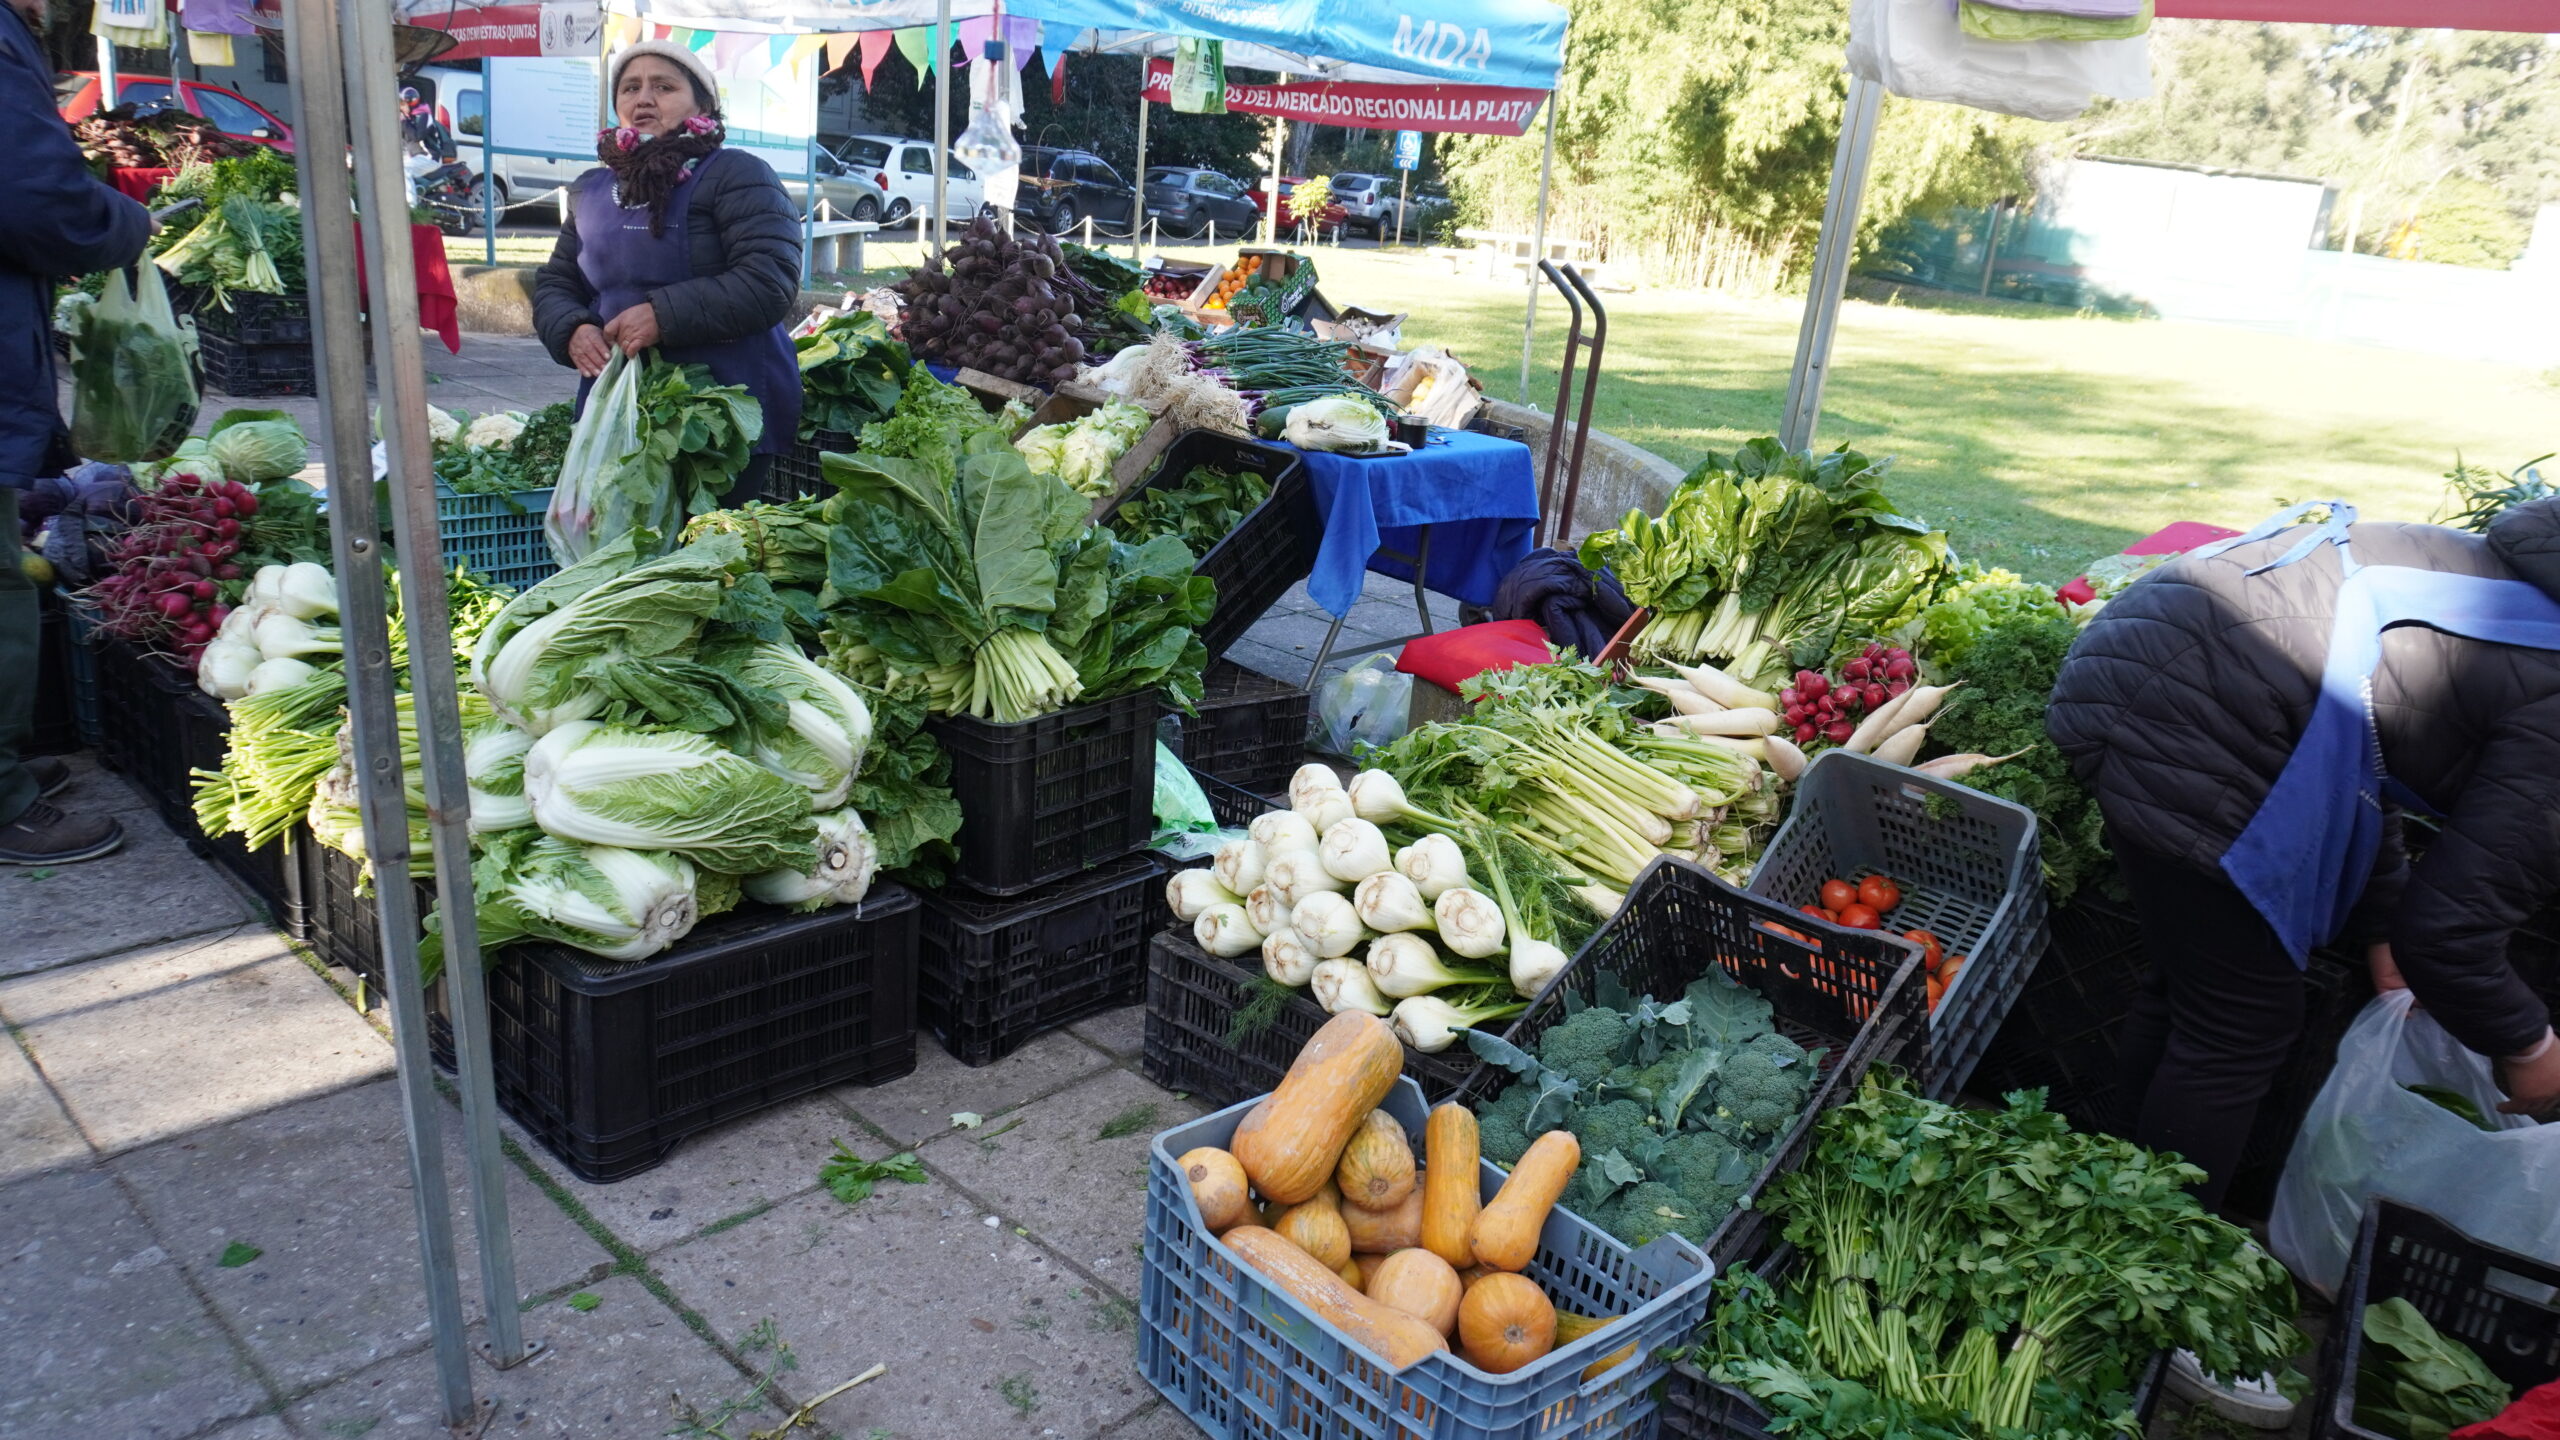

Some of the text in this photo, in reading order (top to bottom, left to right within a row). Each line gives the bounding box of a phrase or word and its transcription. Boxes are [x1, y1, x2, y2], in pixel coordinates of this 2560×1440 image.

[1180, 1, 1238, 23] BUENOS
[1241, 9, 1279, 26] AIRES
[507, 23, 537, 43] QUINTAS
[1393, 14, 1491, 70] MDA
[1244, 89, 1534, 122] DEL MERCADO REGIONAL LA PLATA
